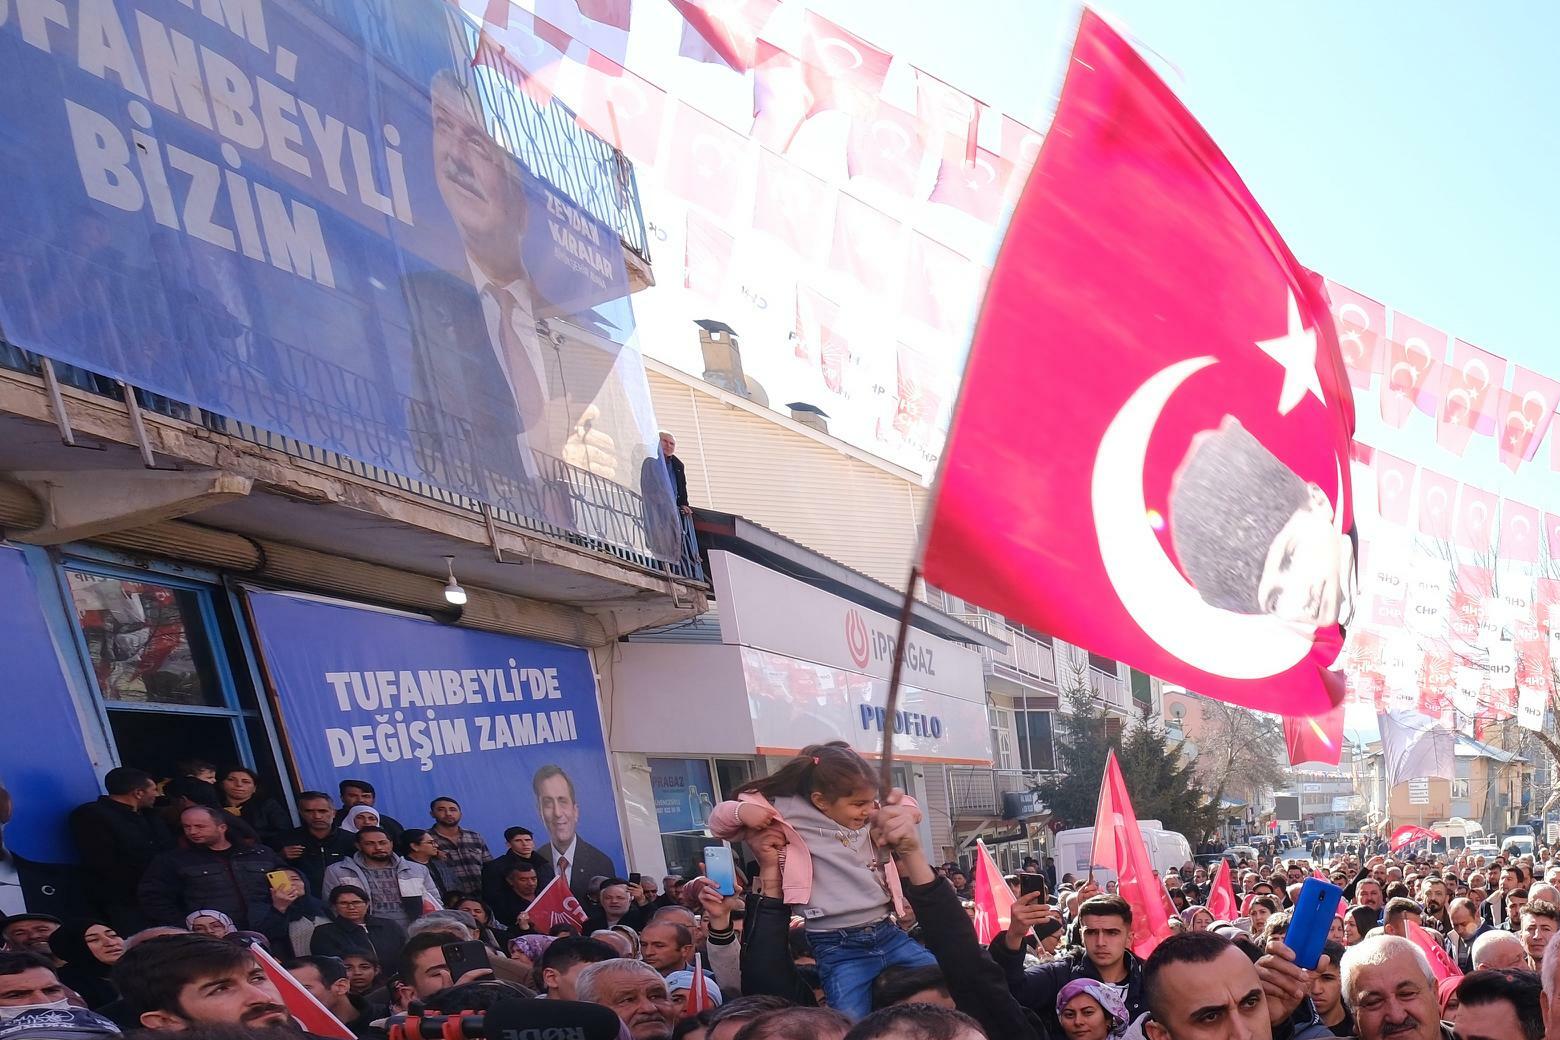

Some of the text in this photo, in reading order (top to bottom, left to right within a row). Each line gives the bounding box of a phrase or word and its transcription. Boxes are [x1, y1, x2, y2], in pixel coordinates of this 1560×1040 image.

[0, 0, 414, 226] FANBEYLİ
[64, 98, 336, 288] BİZİM
[325, 658, 562, 711] TUFANBEYLİ'DE
[325, 709, 578, 772] DEĞİŞİM ZAMANI
